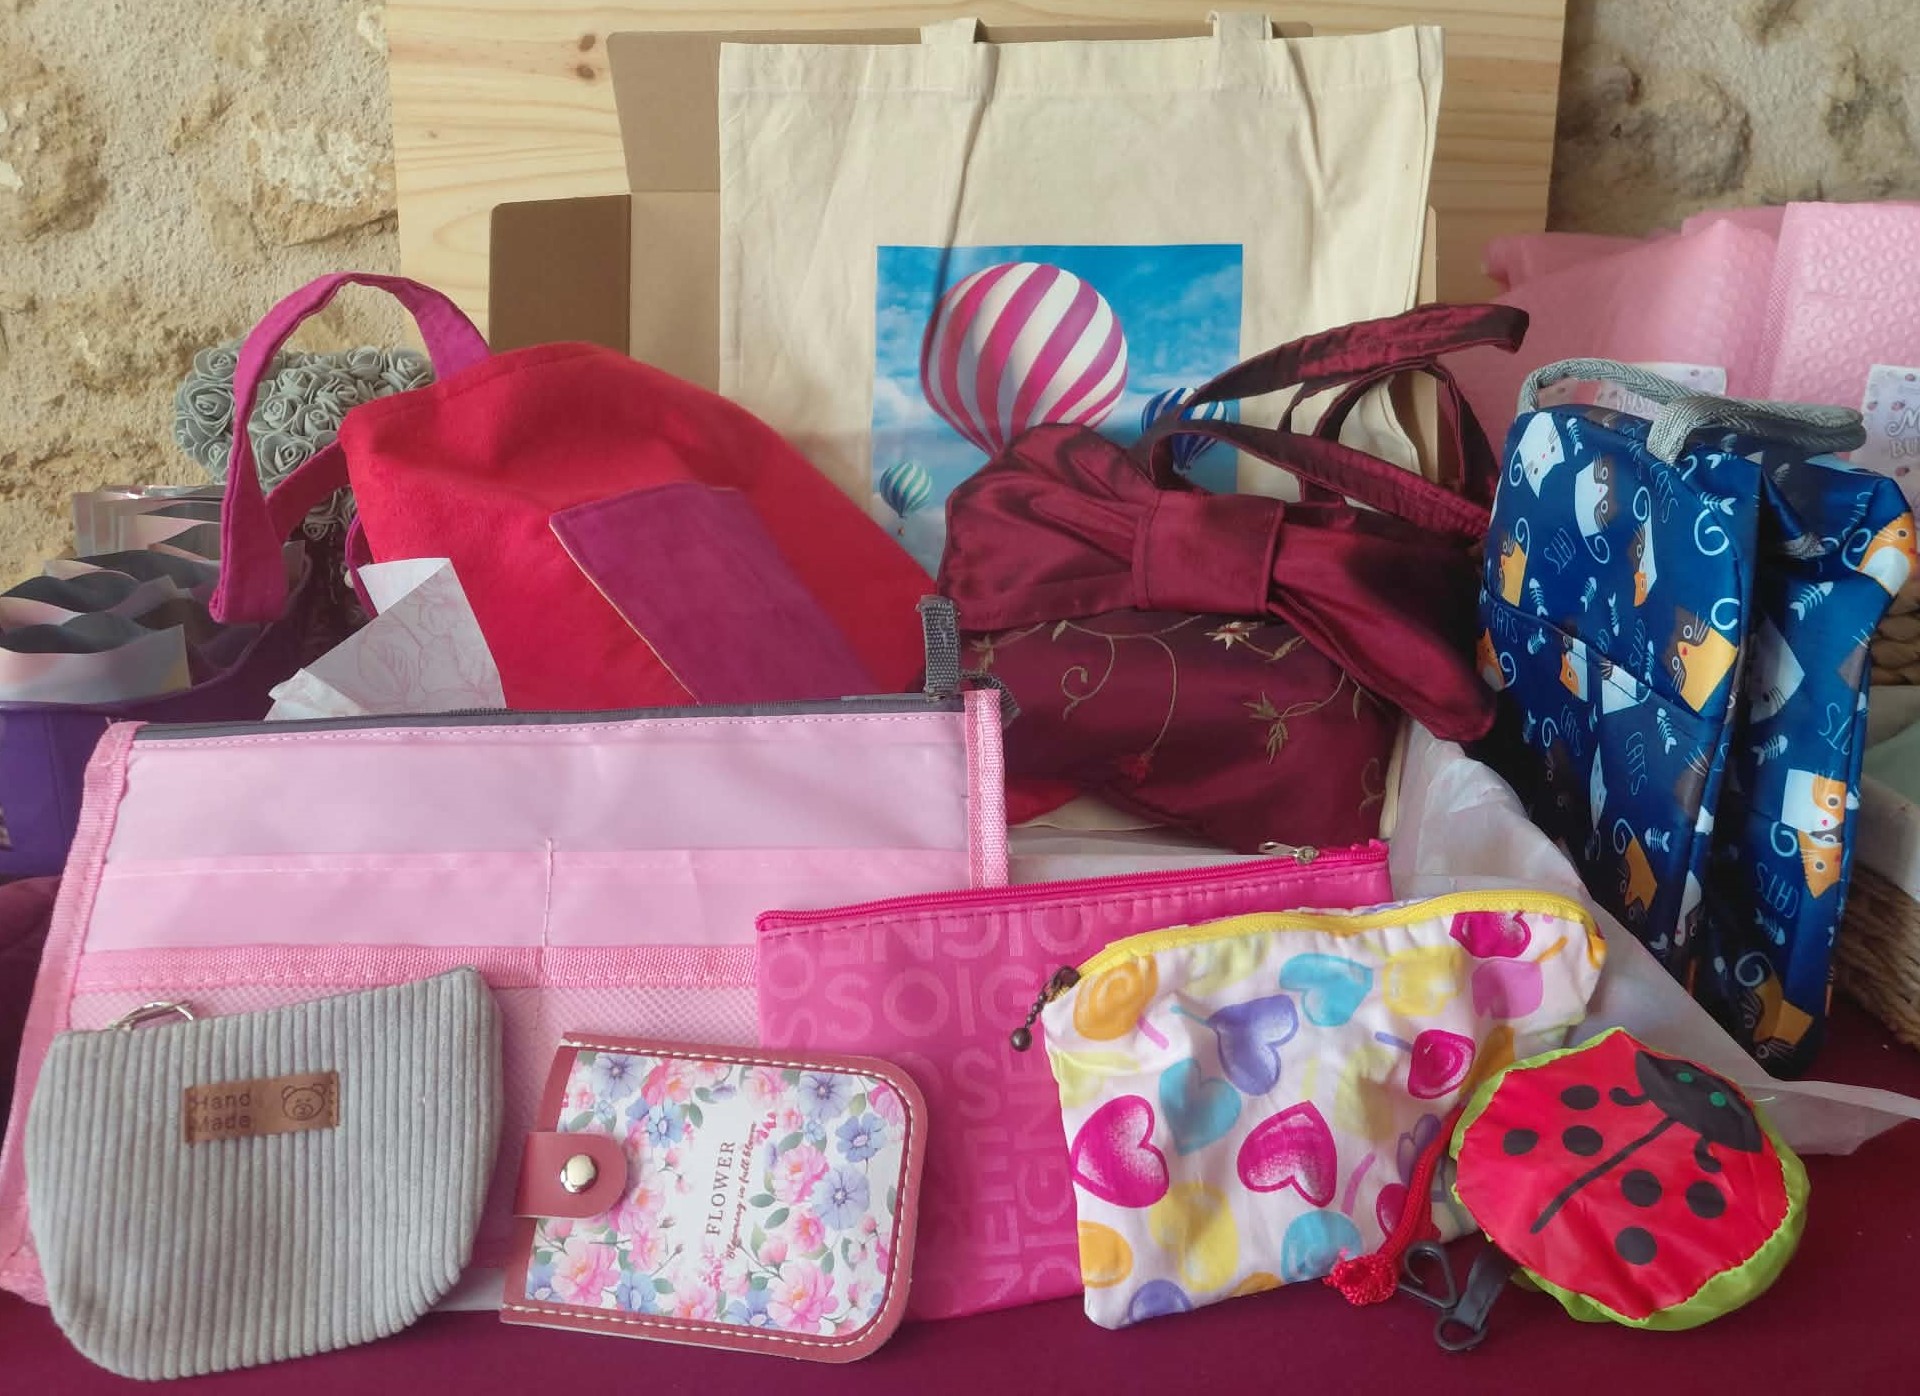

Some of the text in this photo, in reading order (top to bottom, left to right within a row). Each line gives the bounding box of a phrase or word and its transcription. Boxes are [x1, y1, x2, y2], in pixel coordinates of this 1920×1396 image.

[1543, 527, 1578, 575] CATS
[1625, 731, 1649, 796] CATS
[1755, 861, 1800, 919] CATS
[190, 1090, 251, 1112] Hand
[190, 1114, 251, 1134] Made
[704, 1141, 737, 1237] FLOWER
[738, 1159, 750, 1184] full
[737, 1186, 747, 1199] in
